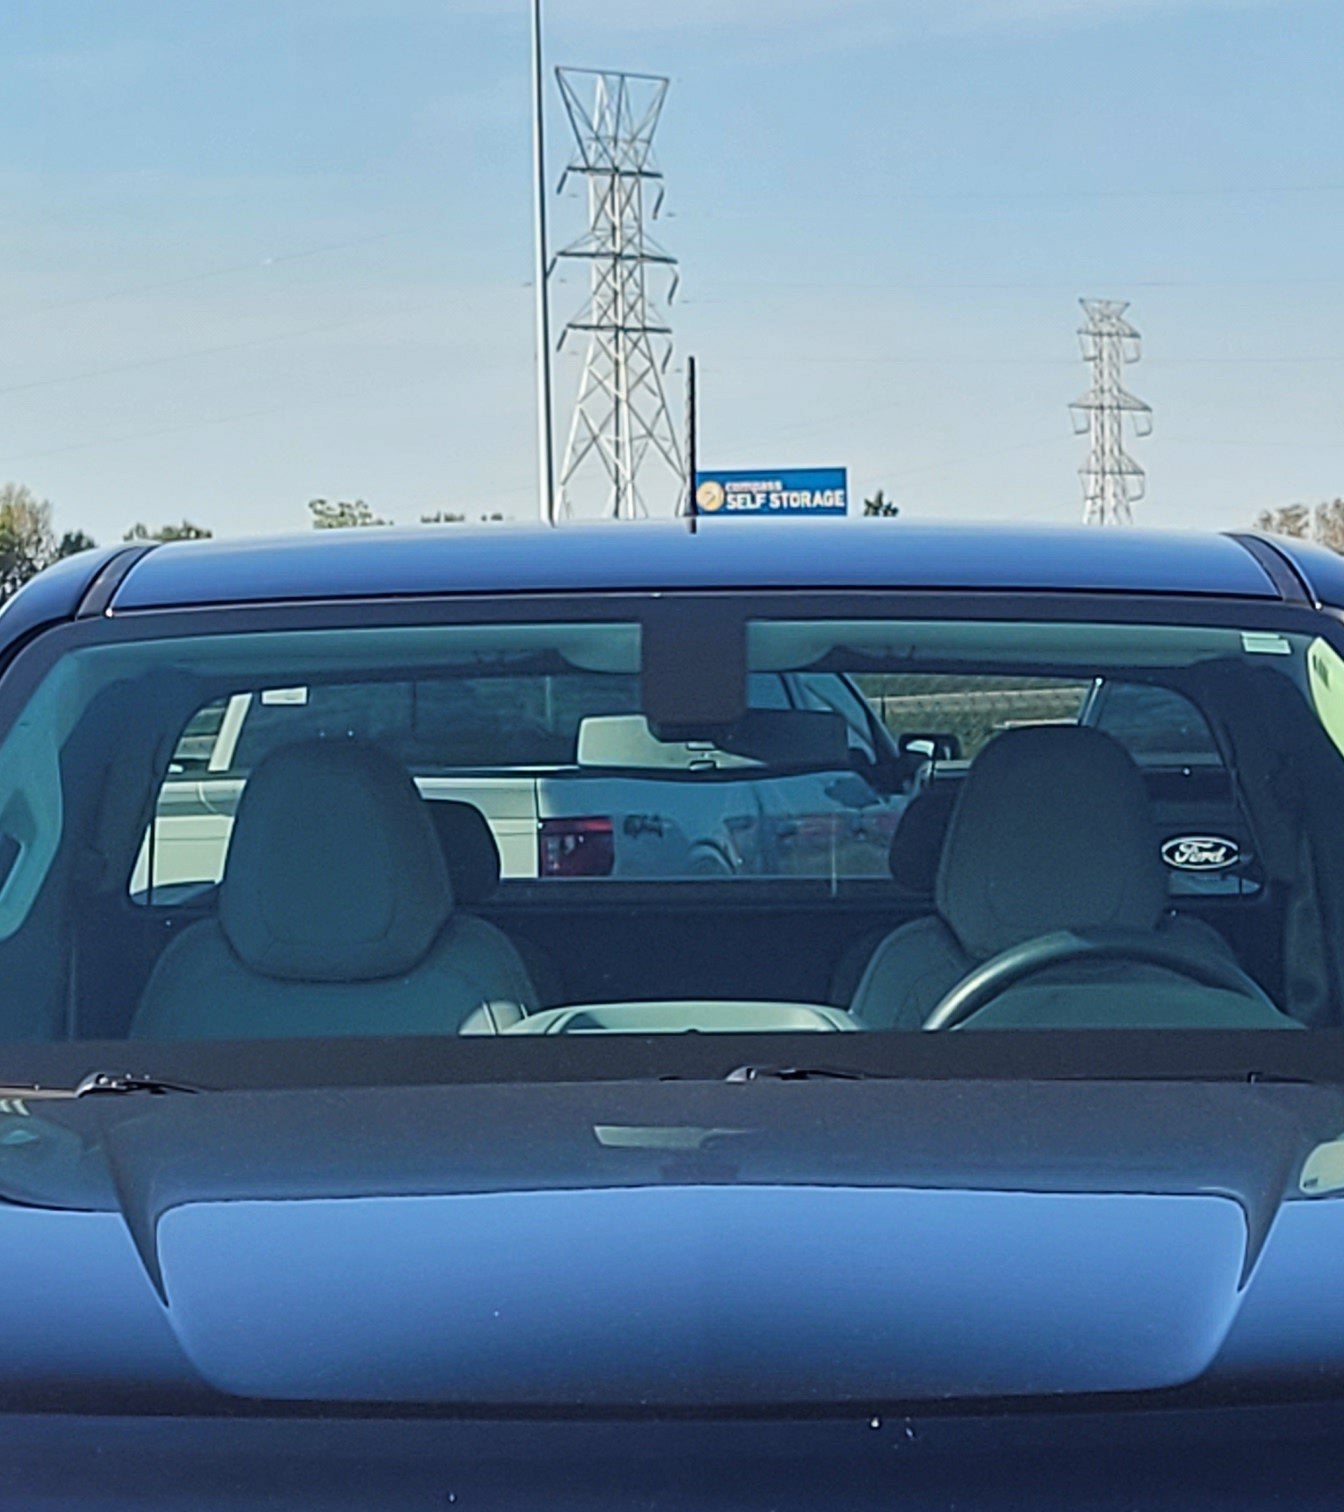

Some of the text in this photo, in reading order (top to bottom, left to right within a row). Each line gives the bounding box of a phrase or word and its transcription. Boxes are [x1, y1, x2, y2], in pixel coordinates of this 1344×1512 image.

[726, 489, 845, 510] SELF STORAGE
[1174, 841, 1227, 863] Ford
